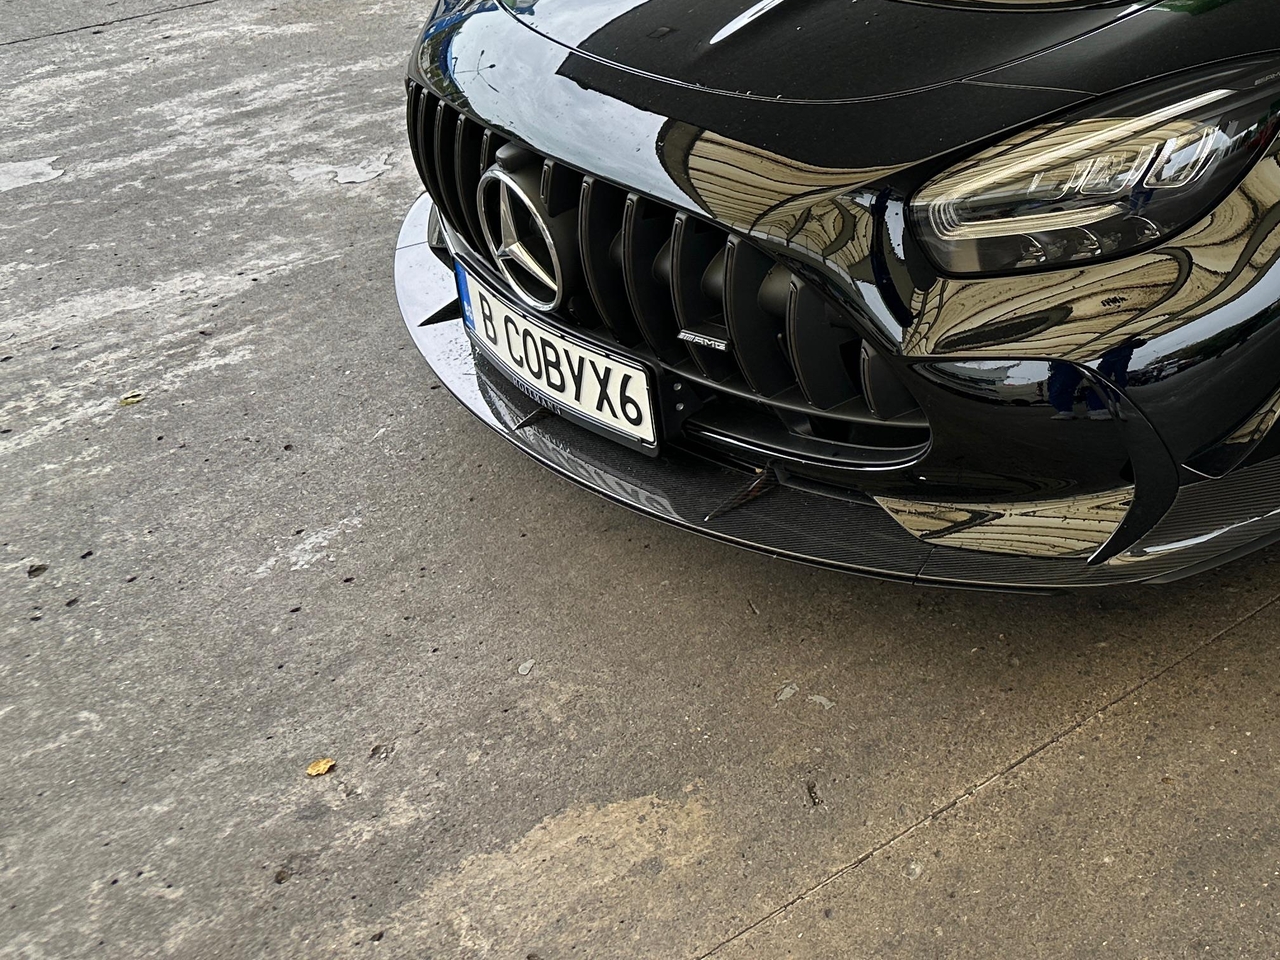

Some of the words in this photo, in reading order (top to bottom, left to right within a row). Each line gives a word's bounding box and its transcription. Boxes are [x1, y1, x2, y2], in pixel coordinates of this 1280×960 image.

[478, 291, 499, 346] B
[503, 314, 643, 427] COBYX6
[685, 334, 729, 352] AMG
